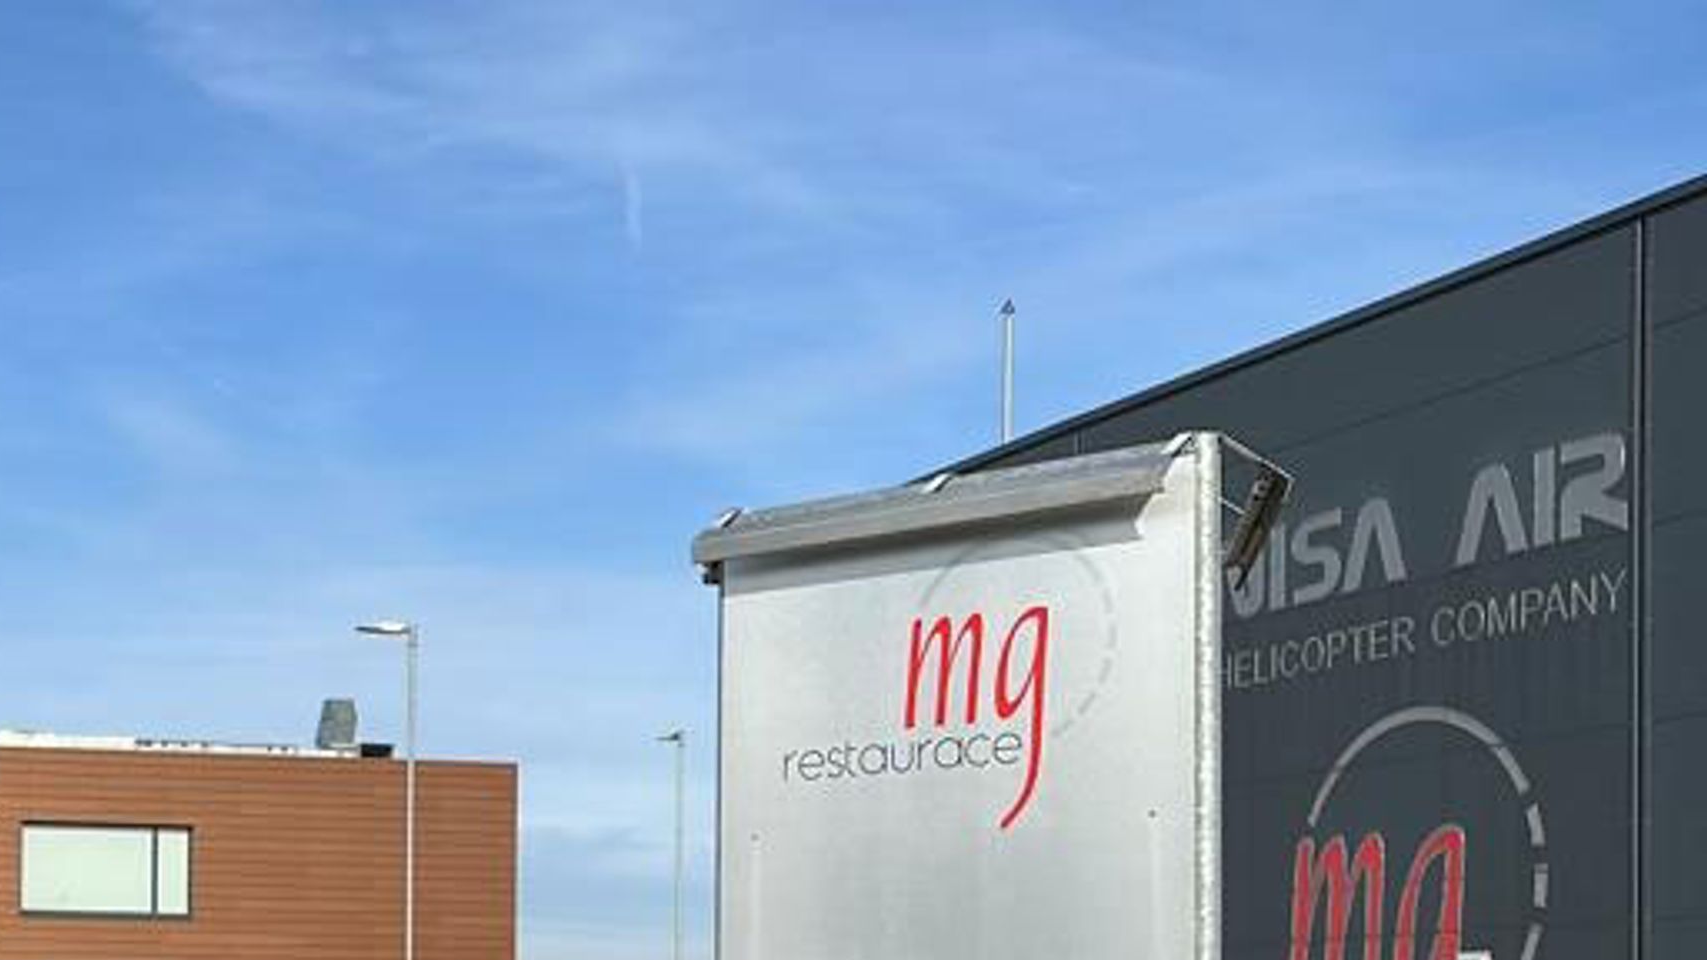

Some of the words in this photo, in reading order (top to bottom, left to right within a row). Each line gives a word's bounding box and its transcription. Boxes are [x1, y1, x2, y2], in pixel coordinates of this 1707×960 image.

[1456, 434, 1628, 567] AIR
[1430, 569, 1626, 647] COMPANY
[783, 730, 1022, 781] restaurace
[905, 605, 1048, 828] mg
